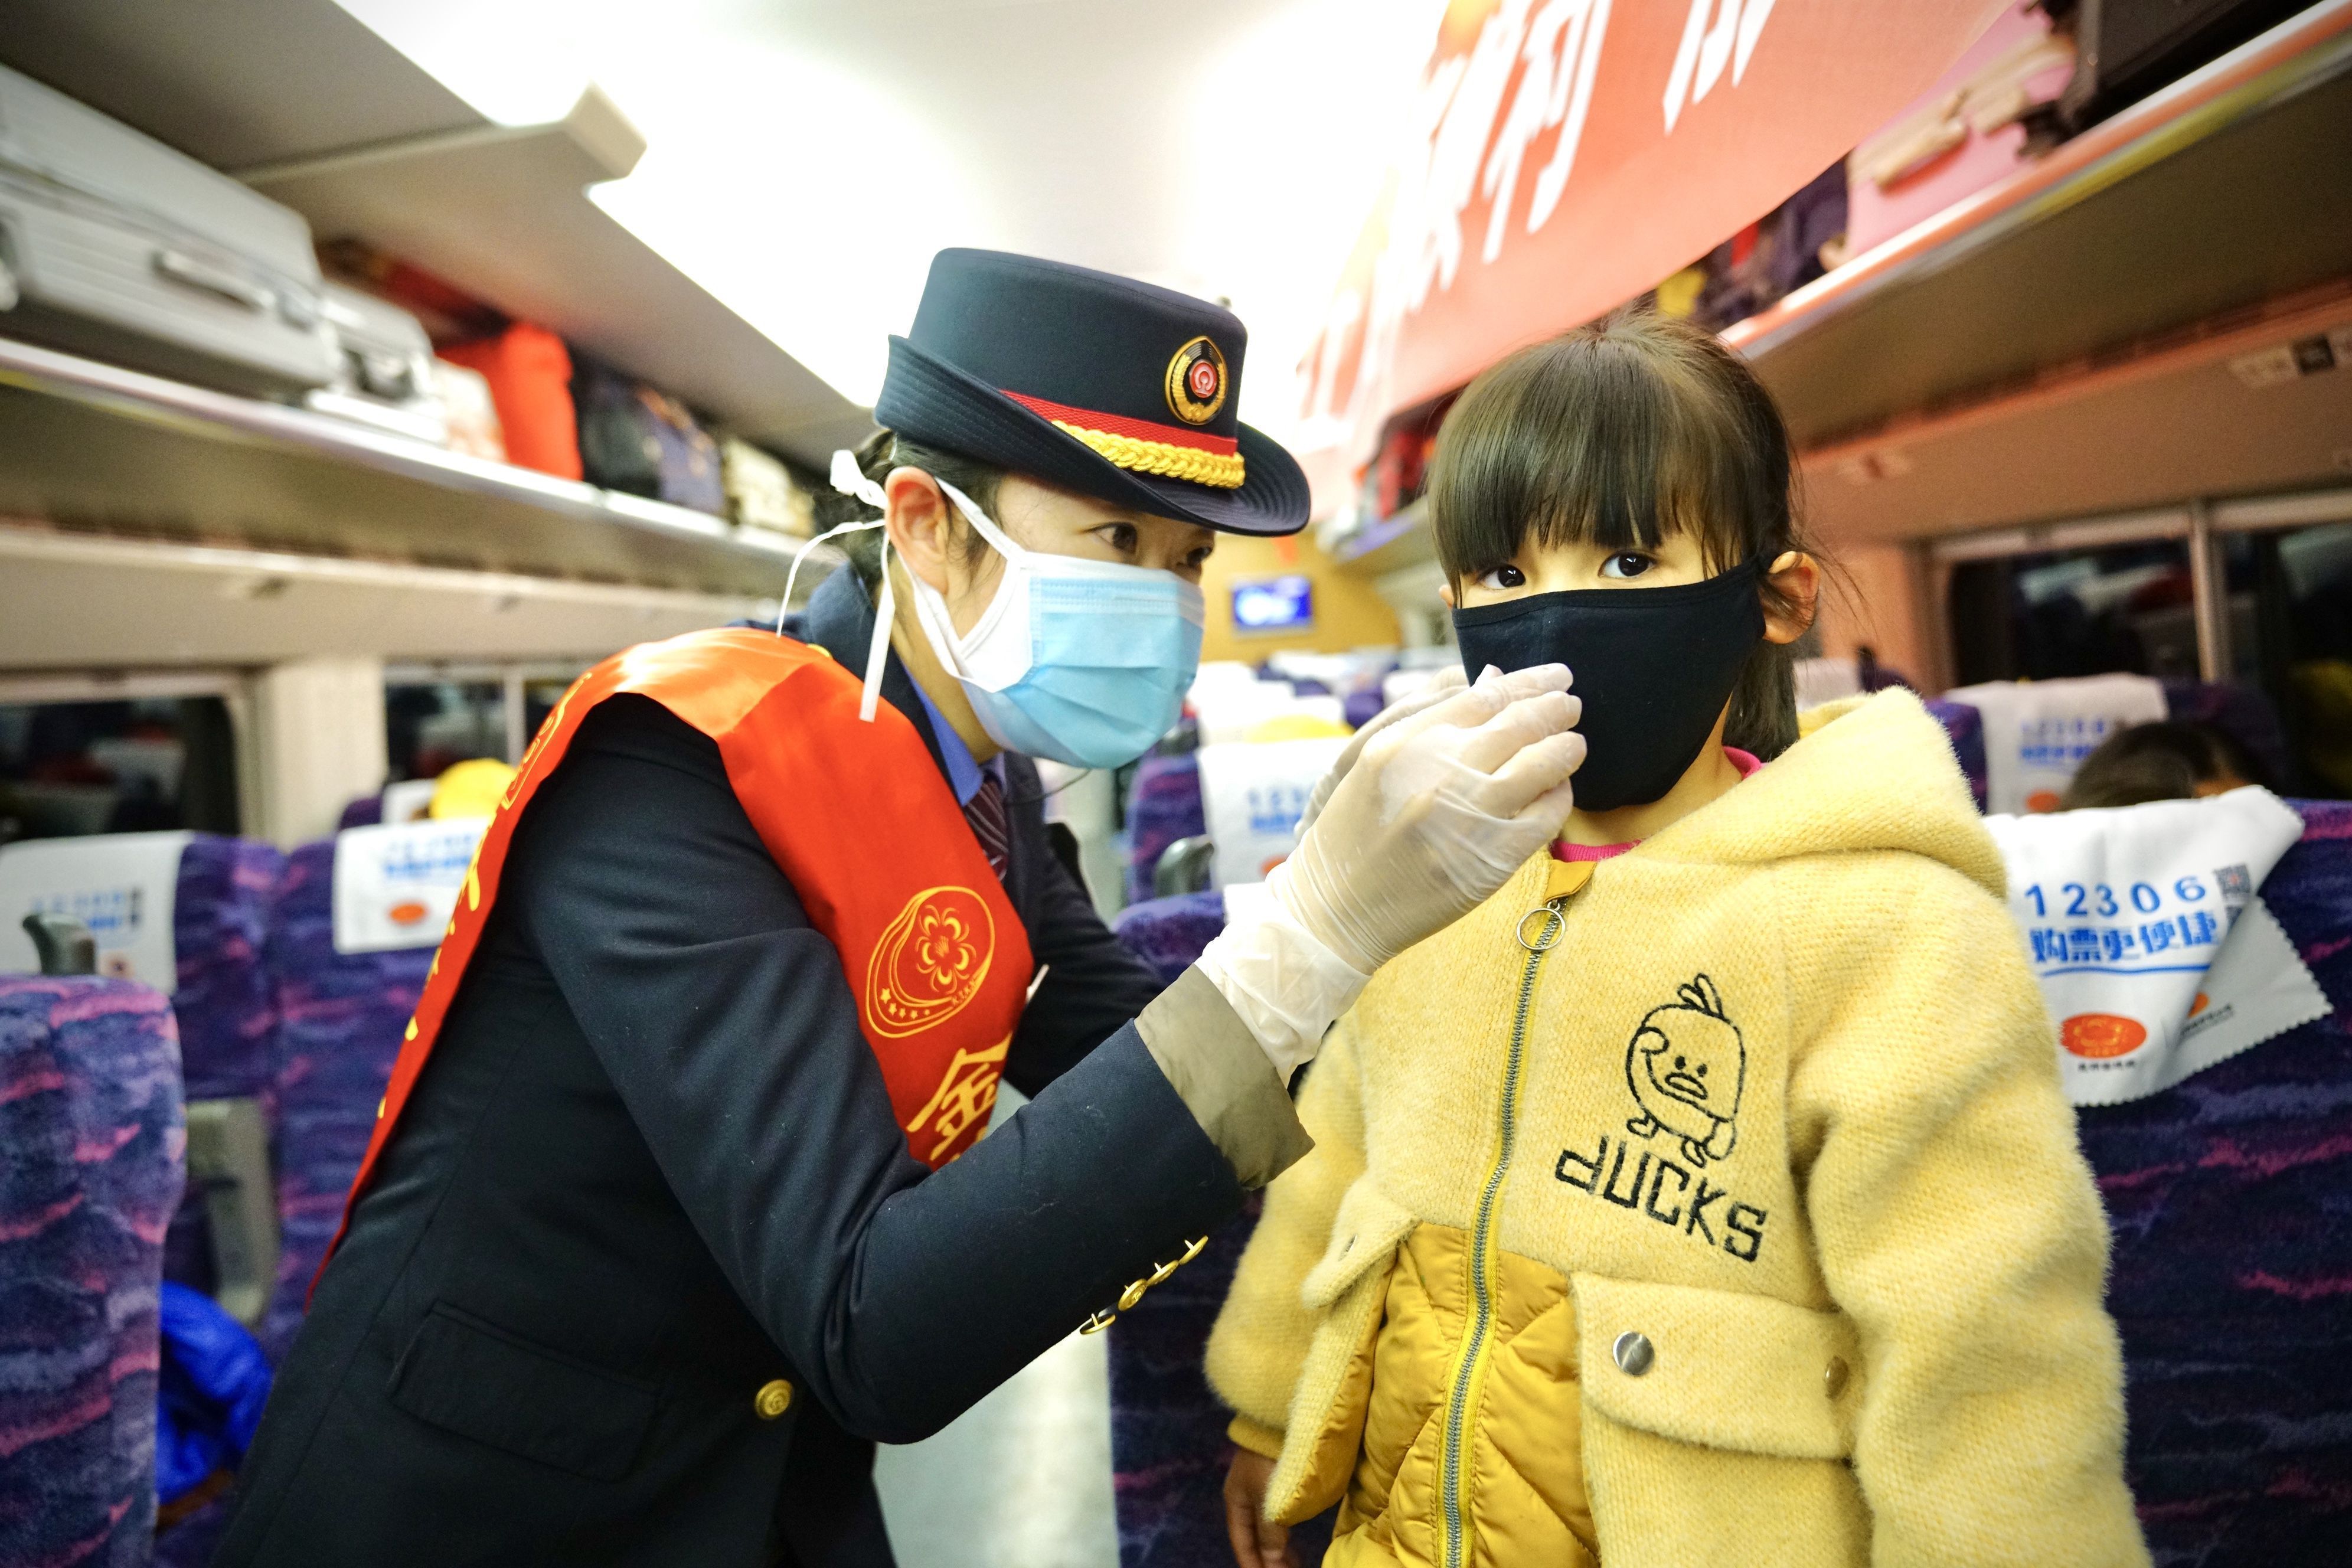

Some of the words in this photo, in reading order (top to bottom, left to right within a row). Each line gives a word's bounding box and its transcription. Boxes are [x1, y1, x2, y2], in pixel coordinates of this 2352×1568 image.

[2025, 877, 2206, 918] 12306
[2030, 911, 2217, 963] 购票更便捷
